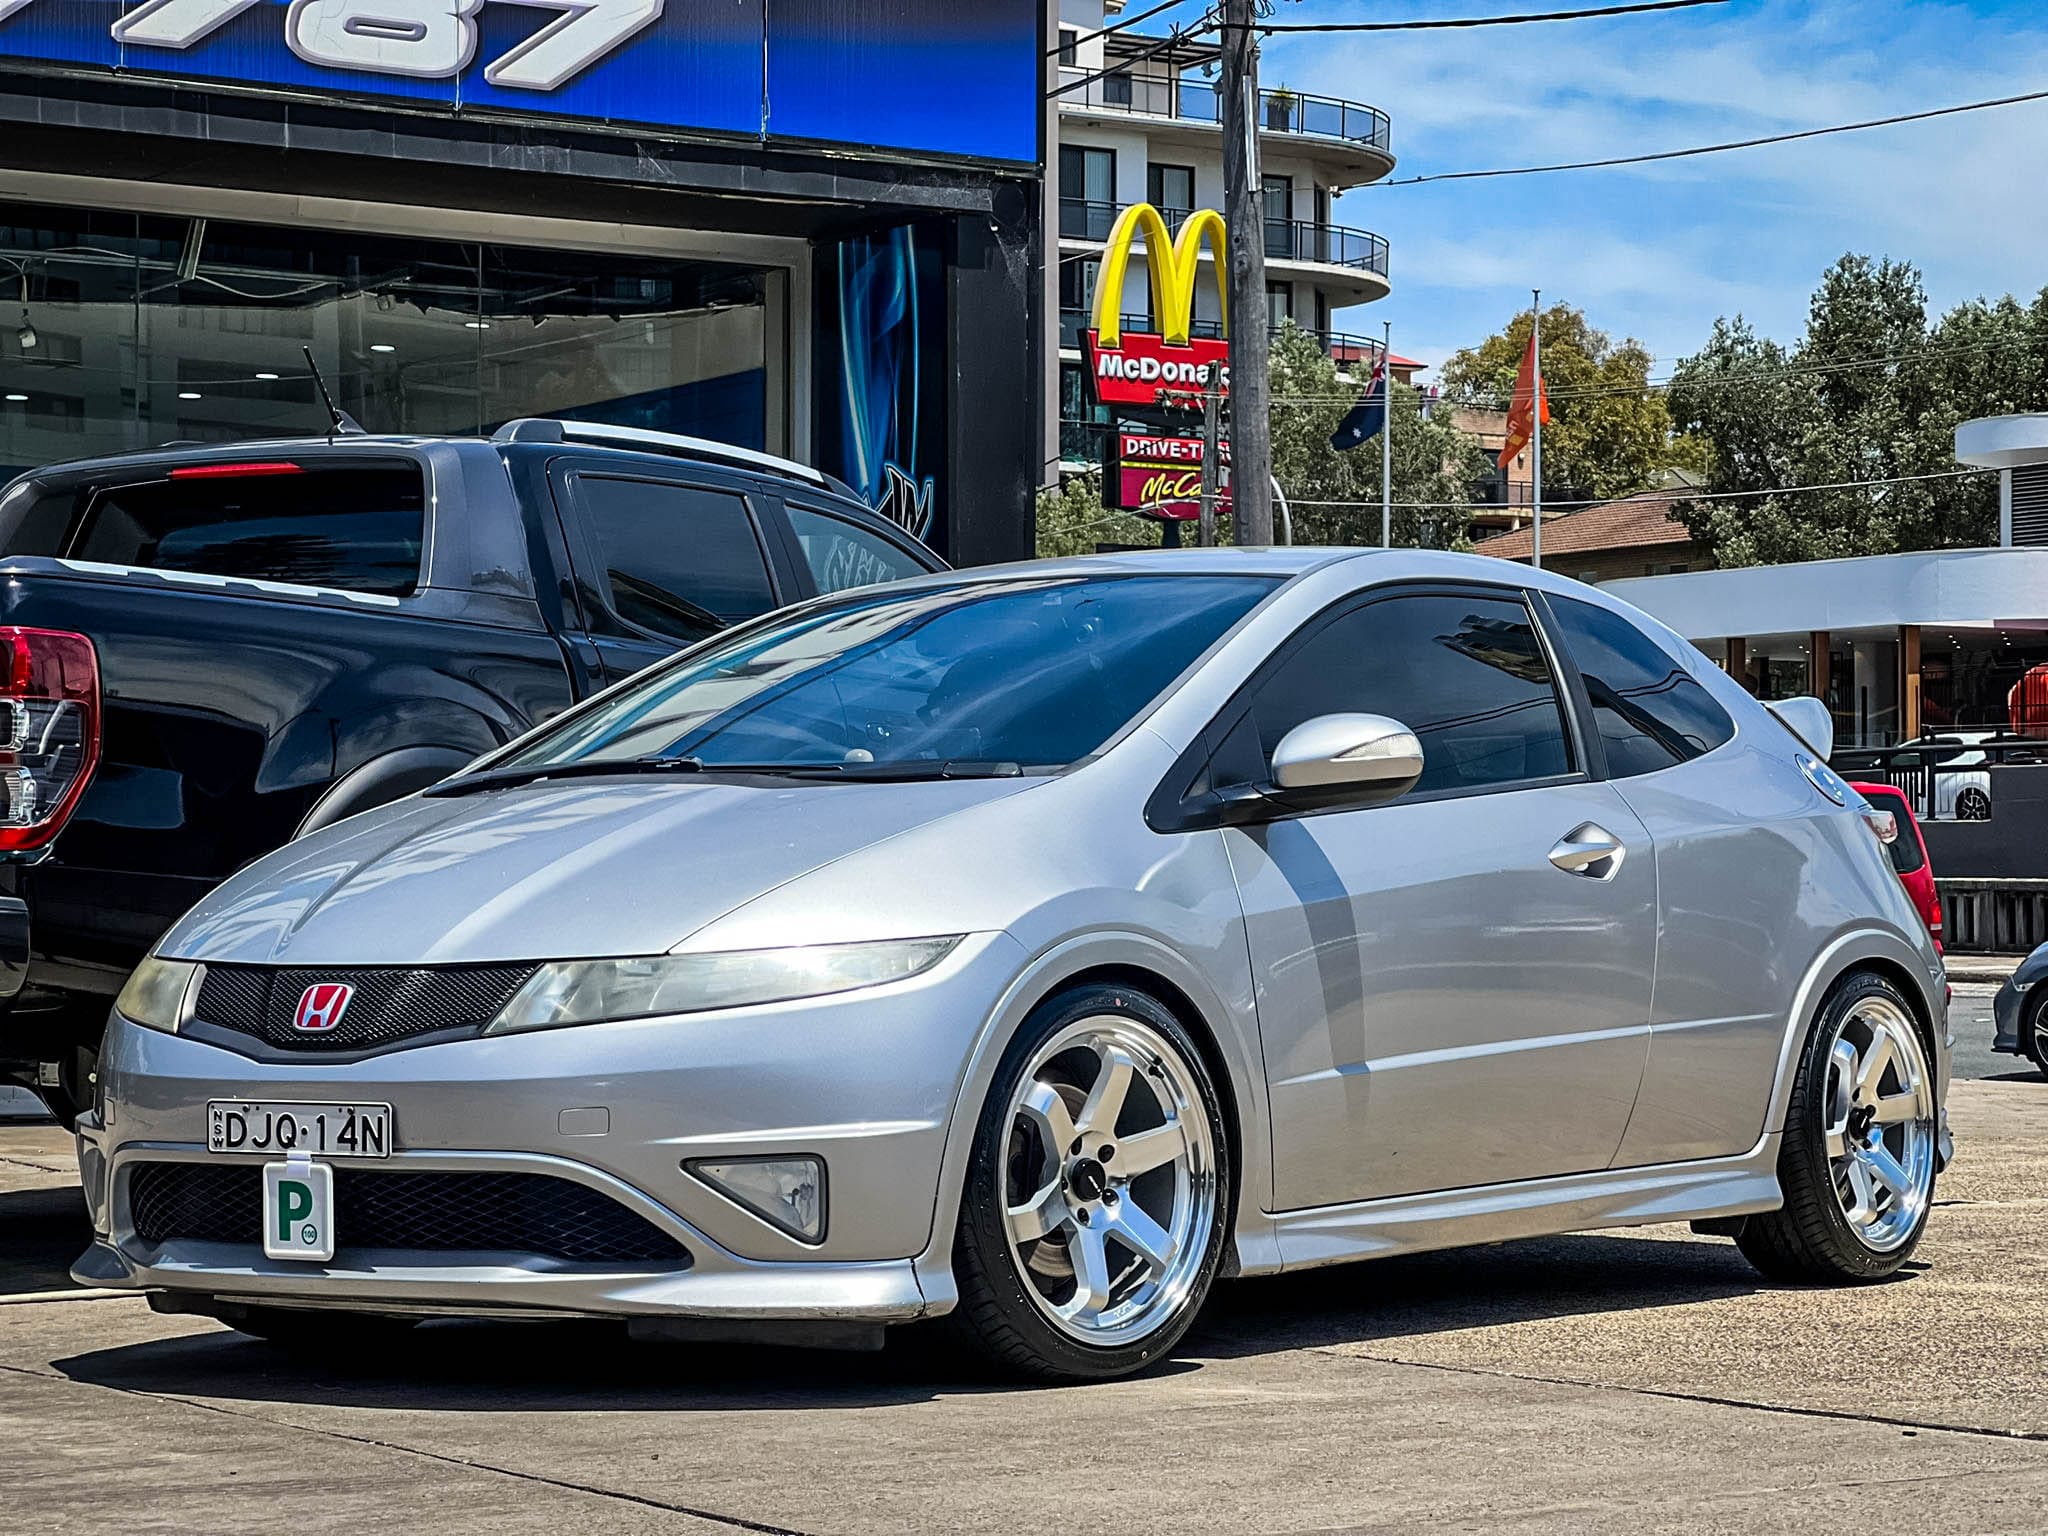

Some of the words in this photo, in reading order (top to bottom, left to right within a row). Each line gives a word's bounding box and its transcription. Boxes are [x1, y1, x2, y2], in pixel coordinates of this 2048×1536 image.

[1097, 353, 1230, 386] McDona
[1140, 472, 1223, 508] McCa
[278, 1180, 313, 1242] P
